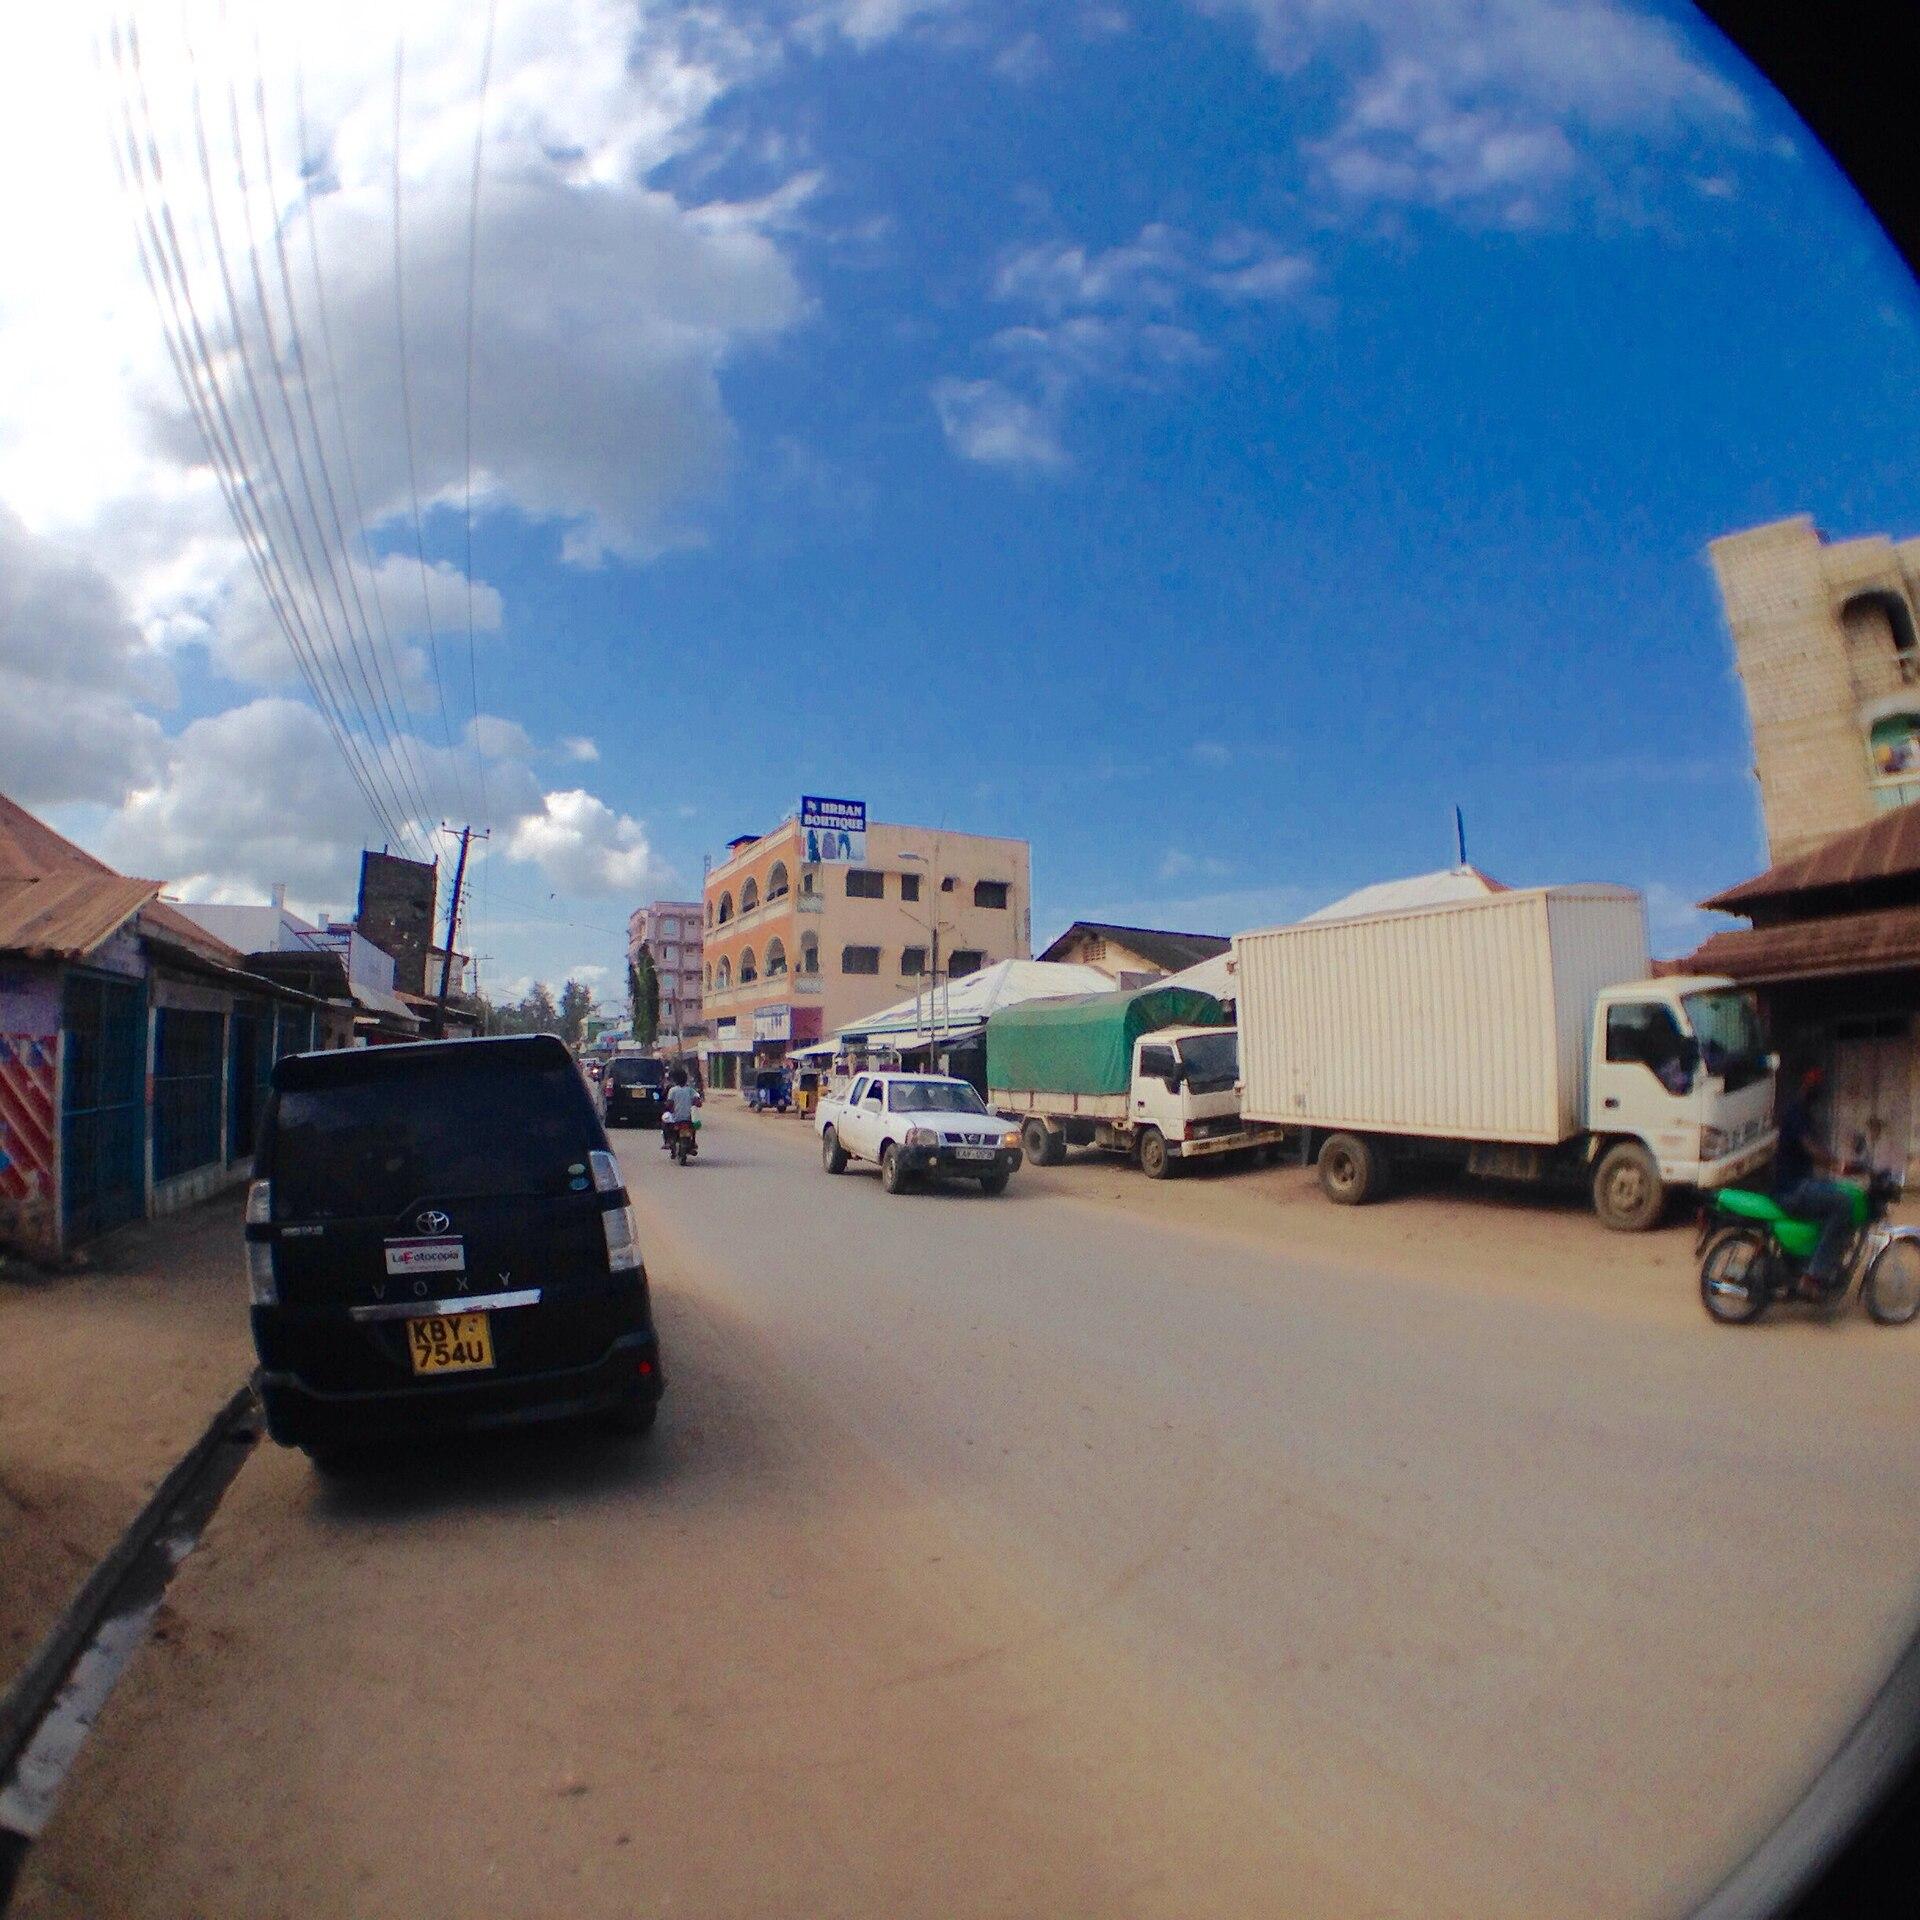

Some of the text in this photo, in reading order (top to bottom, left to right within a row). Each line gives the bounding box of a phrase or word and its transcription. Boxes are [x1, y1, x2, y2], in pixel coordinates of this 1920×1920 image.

[804, 814, 863, 830] BOUTIQUE
[372, 1272, 511, 1299] VOXY
[413, 1317, 463, 1345] KBY
[417, 1340, 484, 1368] 754U
